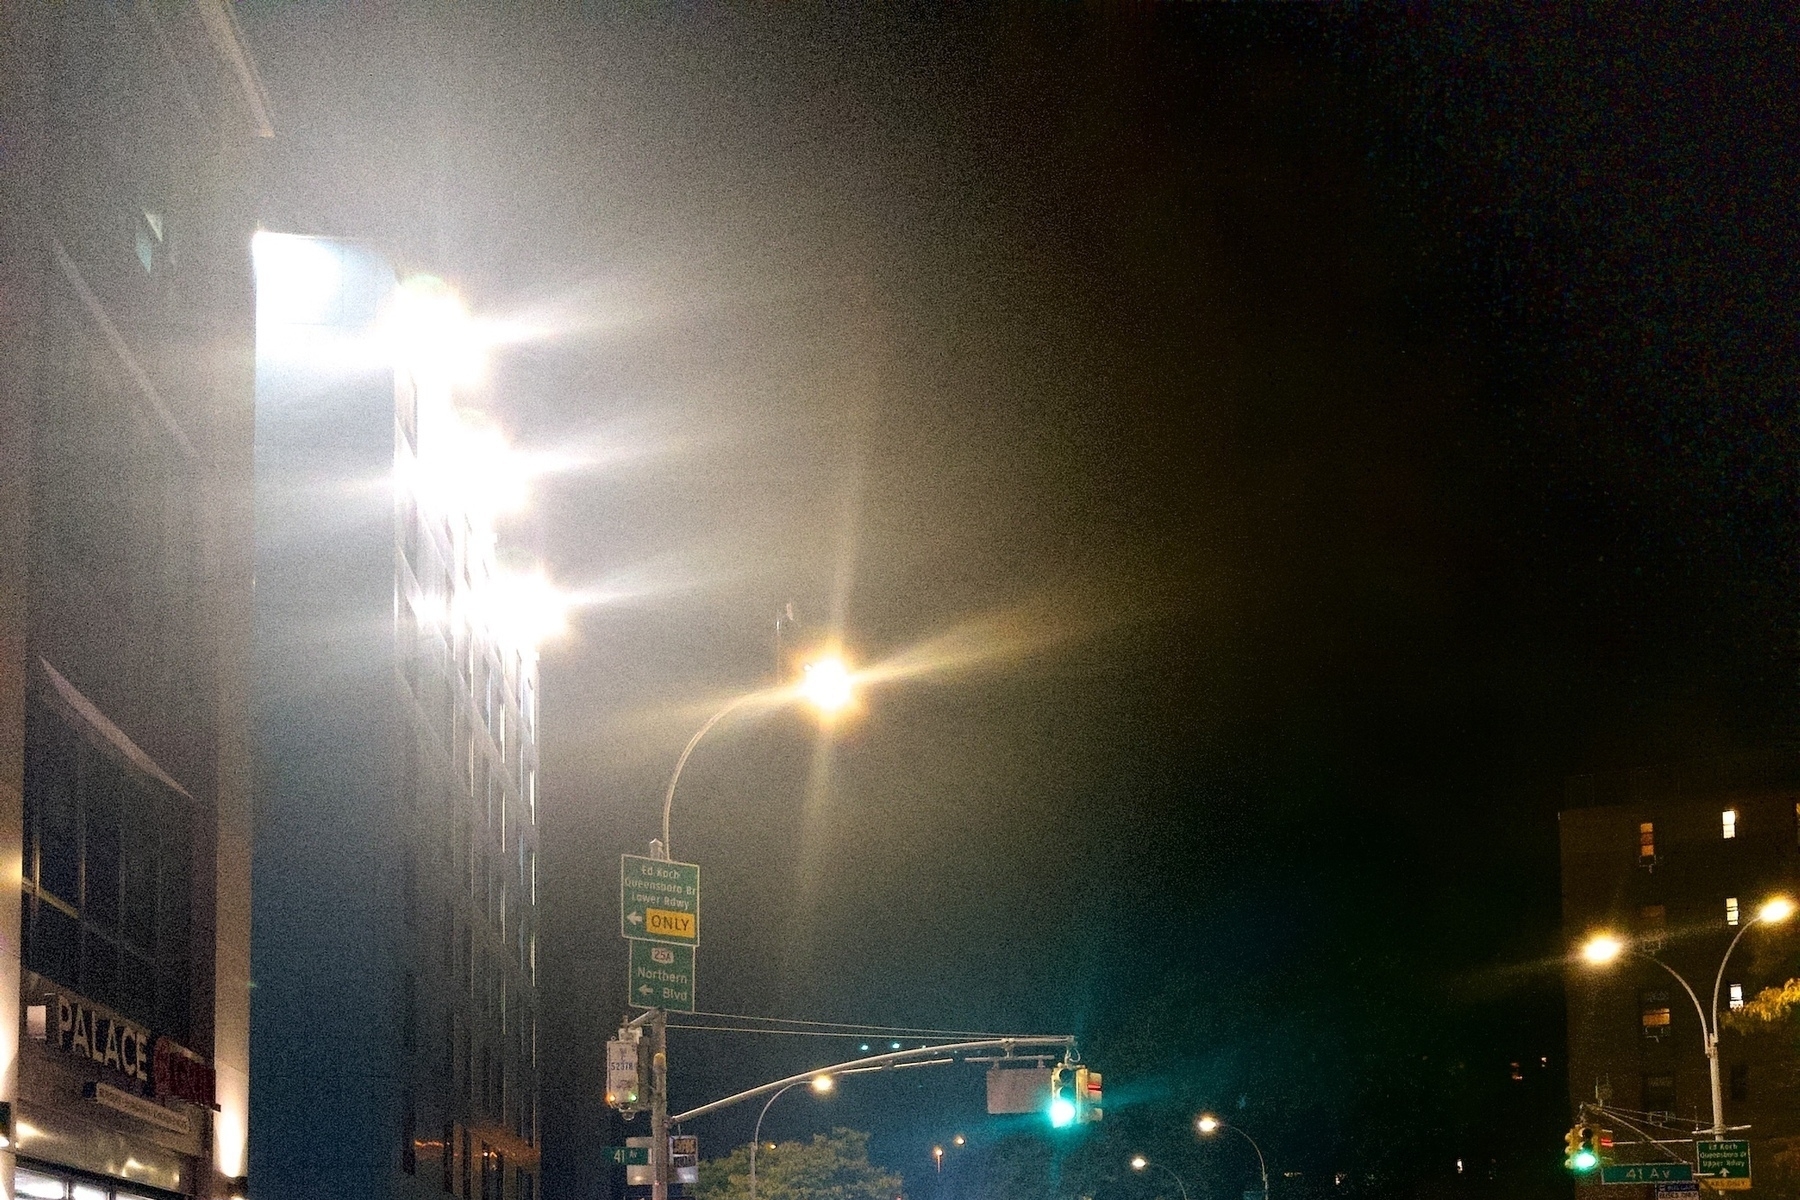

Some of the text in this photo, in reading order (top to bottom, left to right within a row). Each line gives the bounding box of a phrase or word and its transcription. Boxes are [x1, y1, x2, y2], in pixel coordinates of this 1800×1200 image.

[641, 865, 681, 879] Ed Koch
[624, 876, 696, 896] Queensboro Br
[631, 893, 690, 910] Lower Rdwy
[651, 914, 690, 931] ONLY
[654, 949, 672, 961] 25A
[637, 966, 688, 984] Northern
[662, 987, 688, 1000] Blvd
[58, 995, 148, 1082] PALACE
[614, 1149, 625, 1163] 41
[1625, 1168, 1643, 1180] 41
